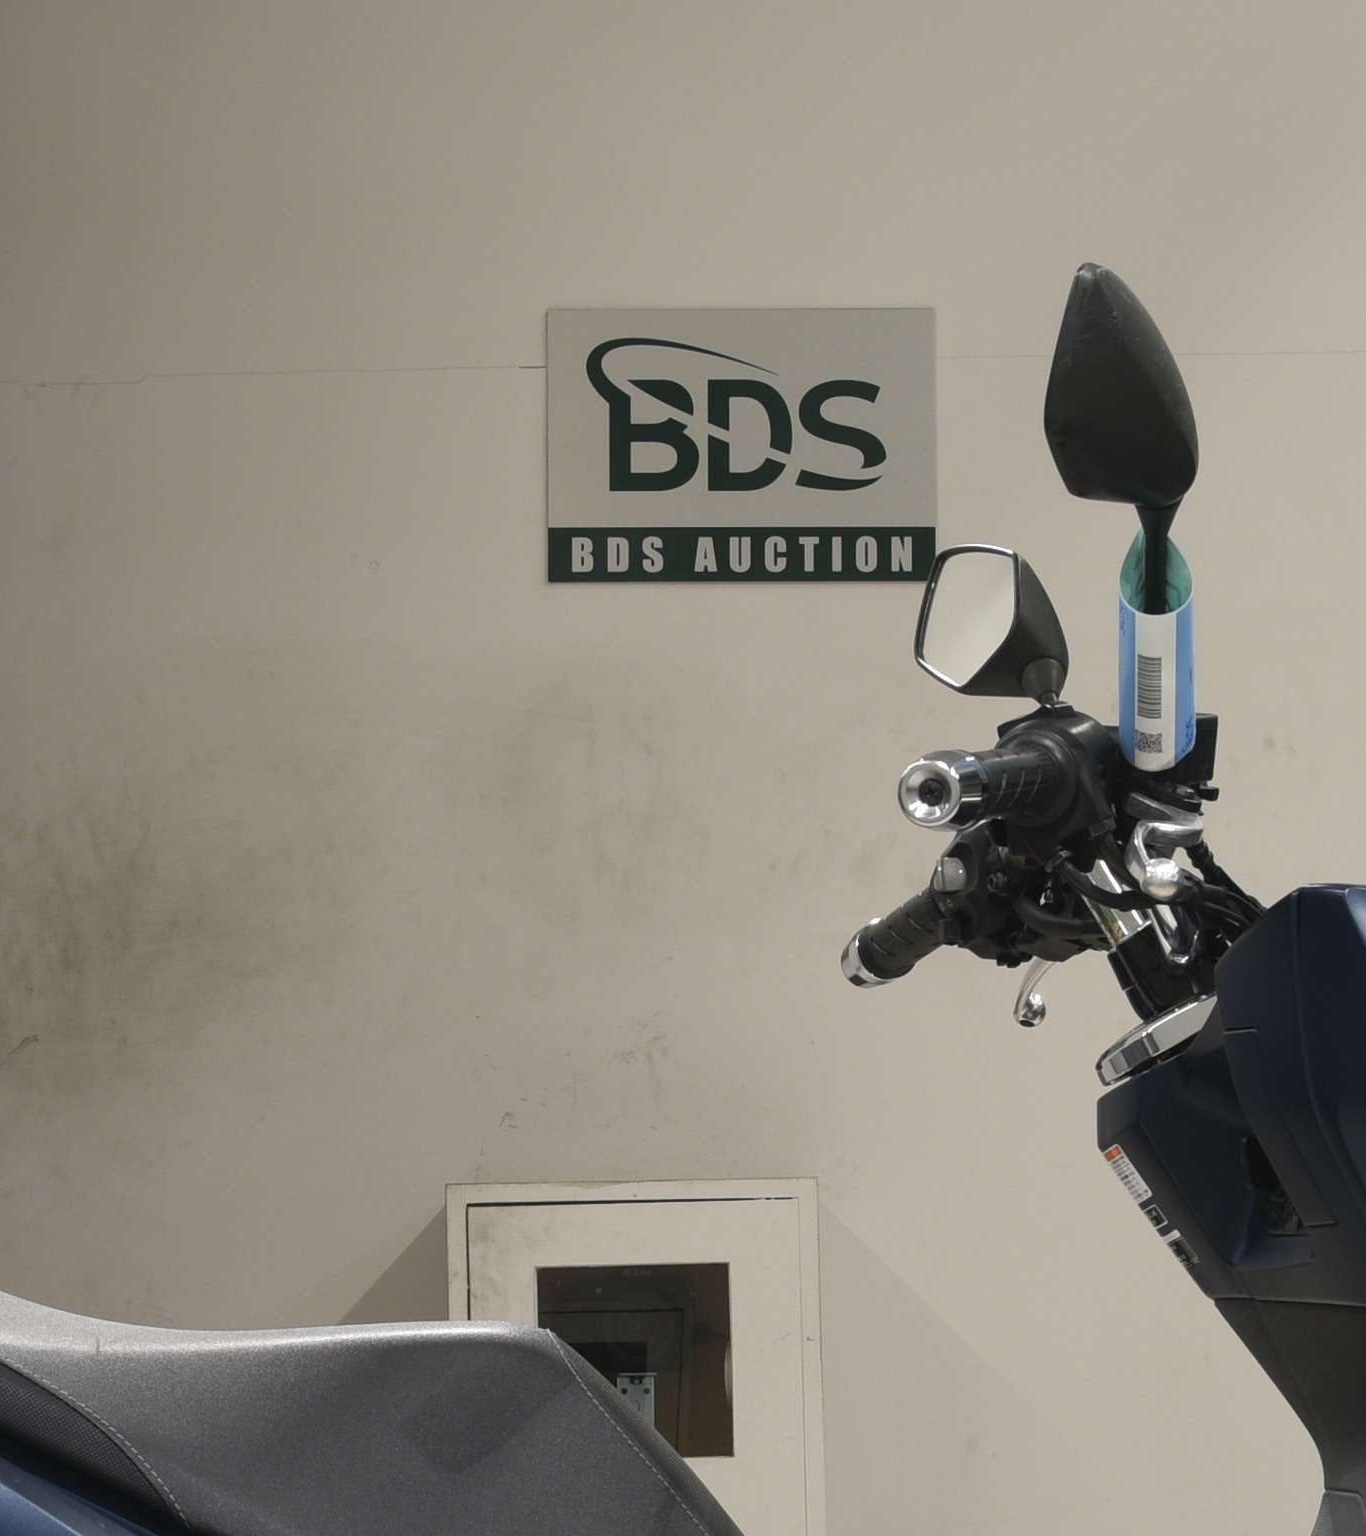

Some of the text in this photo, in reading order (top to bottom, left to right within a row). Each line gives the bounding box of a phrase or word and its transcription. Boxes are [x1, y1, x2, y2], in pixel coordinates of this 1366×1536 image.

[586, 338, 887, 491] BDS
[571, 536, 914, 573] BDS AUCTION
